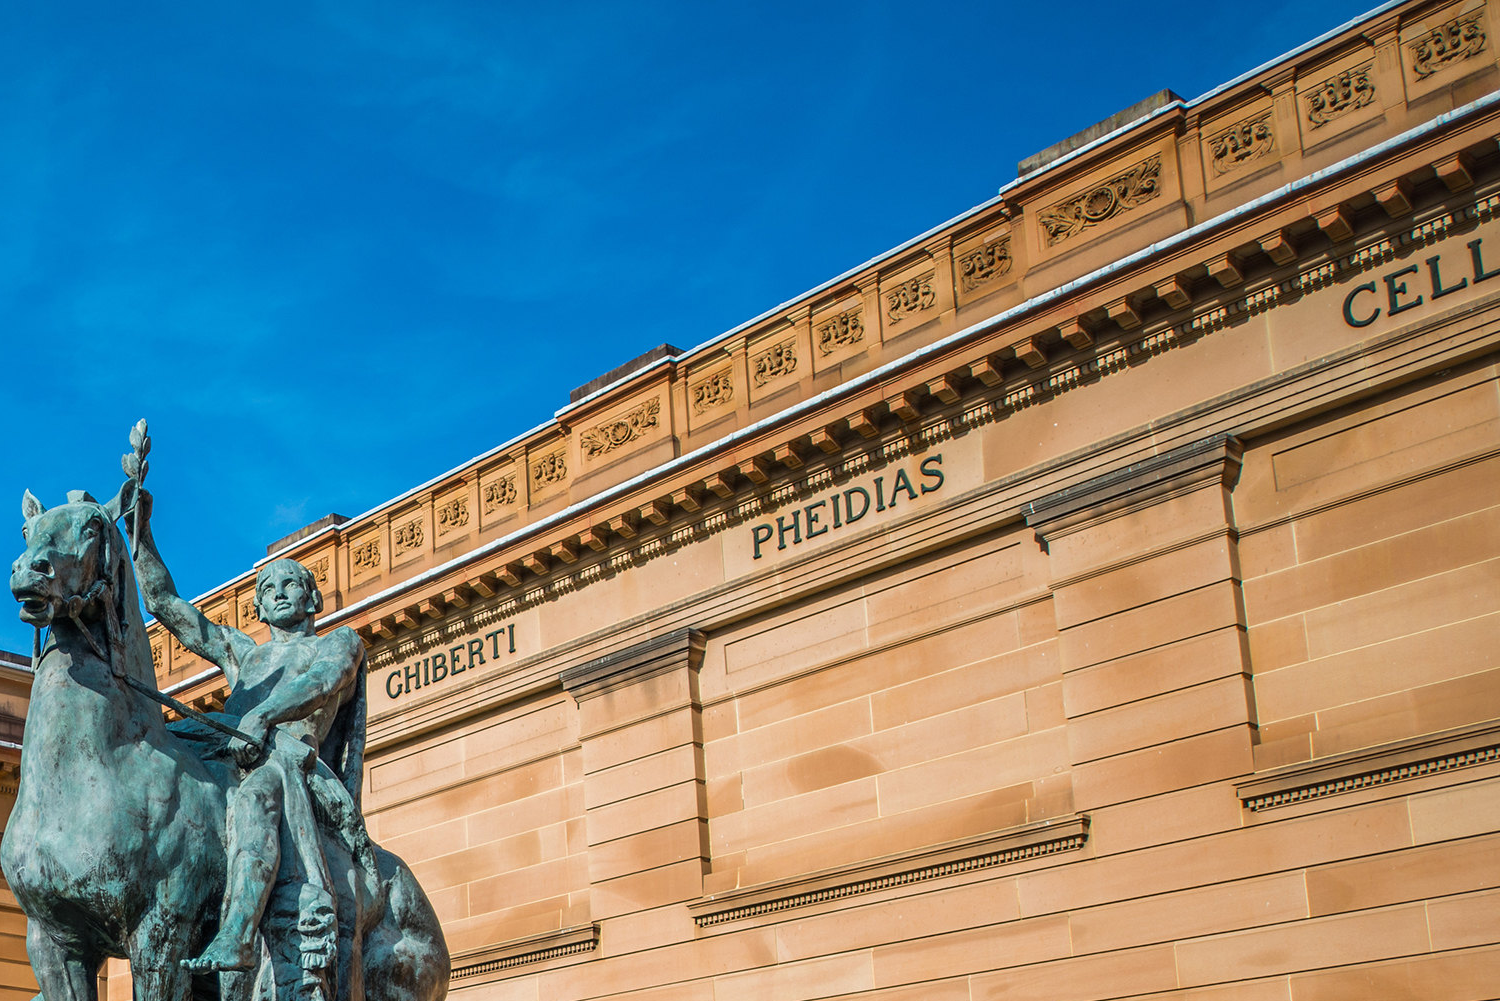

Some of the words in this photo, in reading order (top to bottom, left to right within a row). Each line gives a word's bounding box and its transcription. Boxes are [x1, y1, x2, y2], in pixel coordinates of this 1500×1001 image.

[1343, 238, 1500, 328] CELL
[751, 453, 945, 559] PHEIDIAS
[386, 623, 516, 698] GHIBERTI
